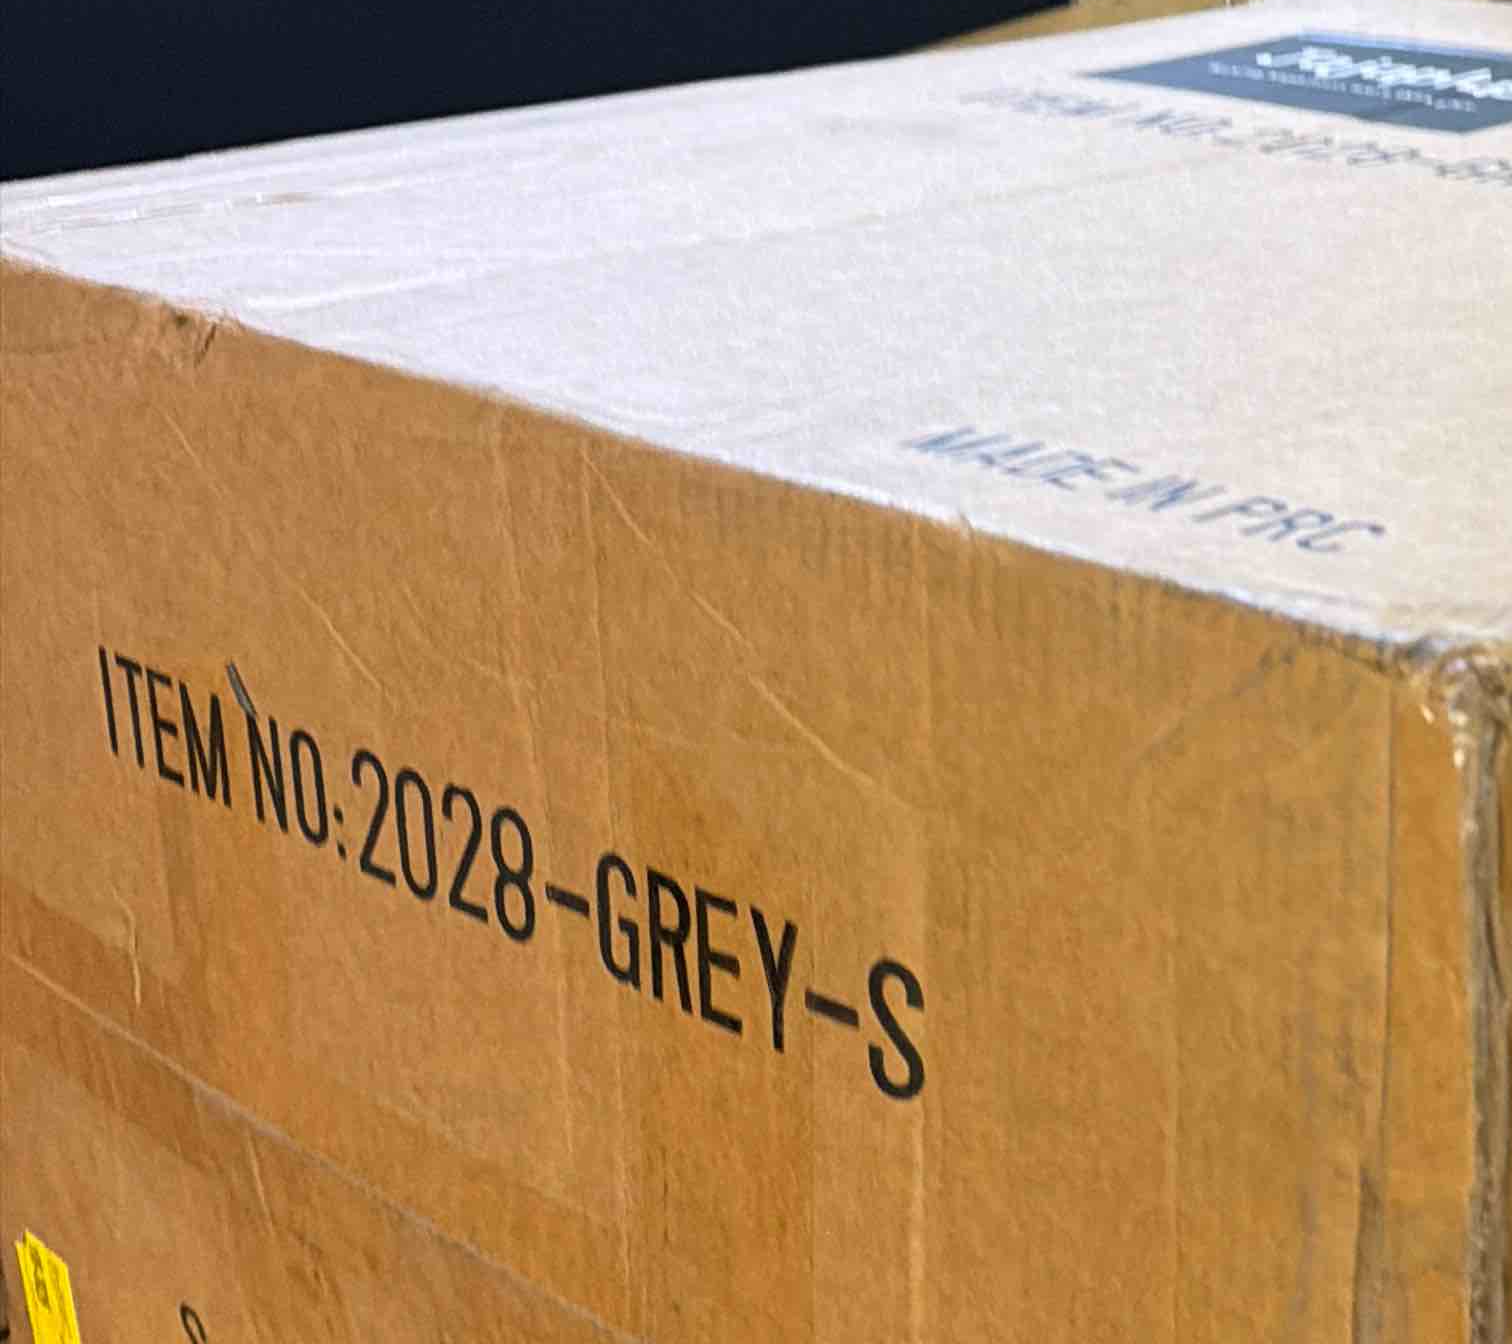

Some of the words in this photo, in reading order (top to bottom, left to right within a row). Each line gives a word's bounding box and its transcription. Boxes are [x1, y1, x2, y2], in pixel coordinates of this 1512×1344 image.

[1193, 495, 1386, 553] PRC
[97, 645, 233, 809] ITEM
[249, 709, 927, 1101] NO:2028-GREY-S
